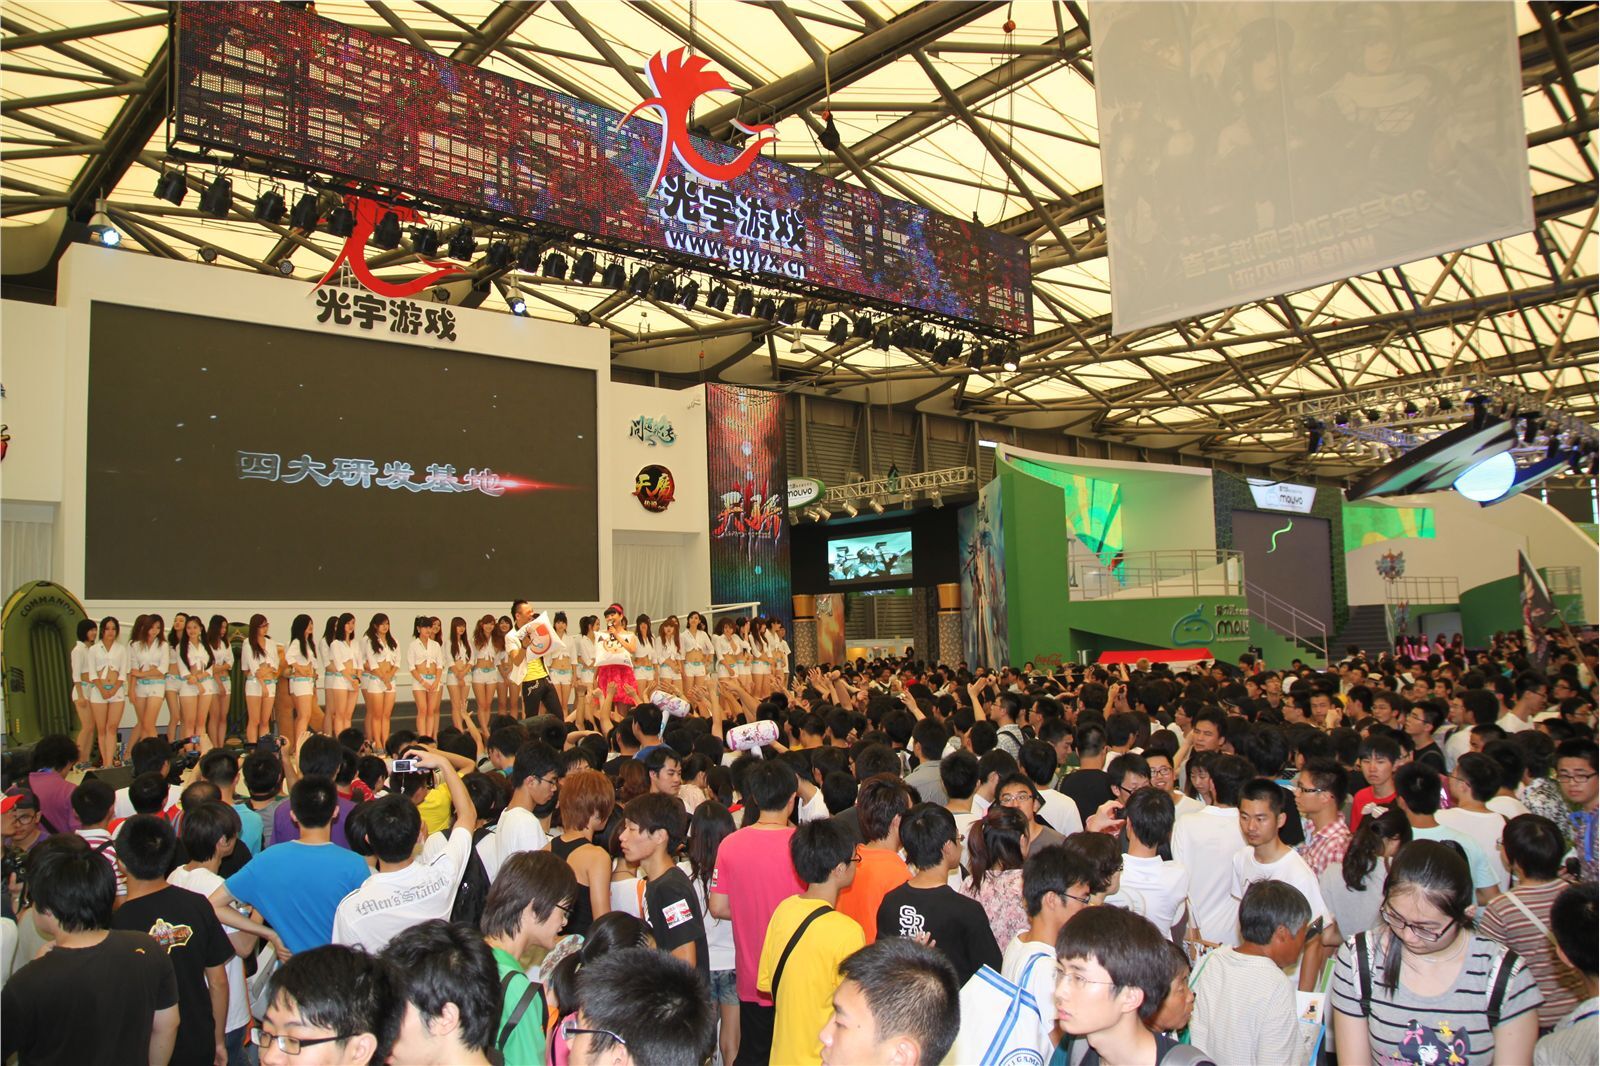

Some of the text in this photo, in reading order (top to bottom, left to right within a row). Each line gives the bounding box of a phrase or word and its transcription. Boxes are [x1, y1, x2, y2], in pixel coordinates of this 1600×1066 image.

[662, 175, 807, 251] 光宇游戏
[666, 231, 806, 279] www.gyyx.cn
[316, 288, 457, 342] 光宇游戏
[237, 450, 506, 497] 四大研发基地
[20, 595, 75, 617] COMMANDO
[357, 893, 401, 915] Men's
